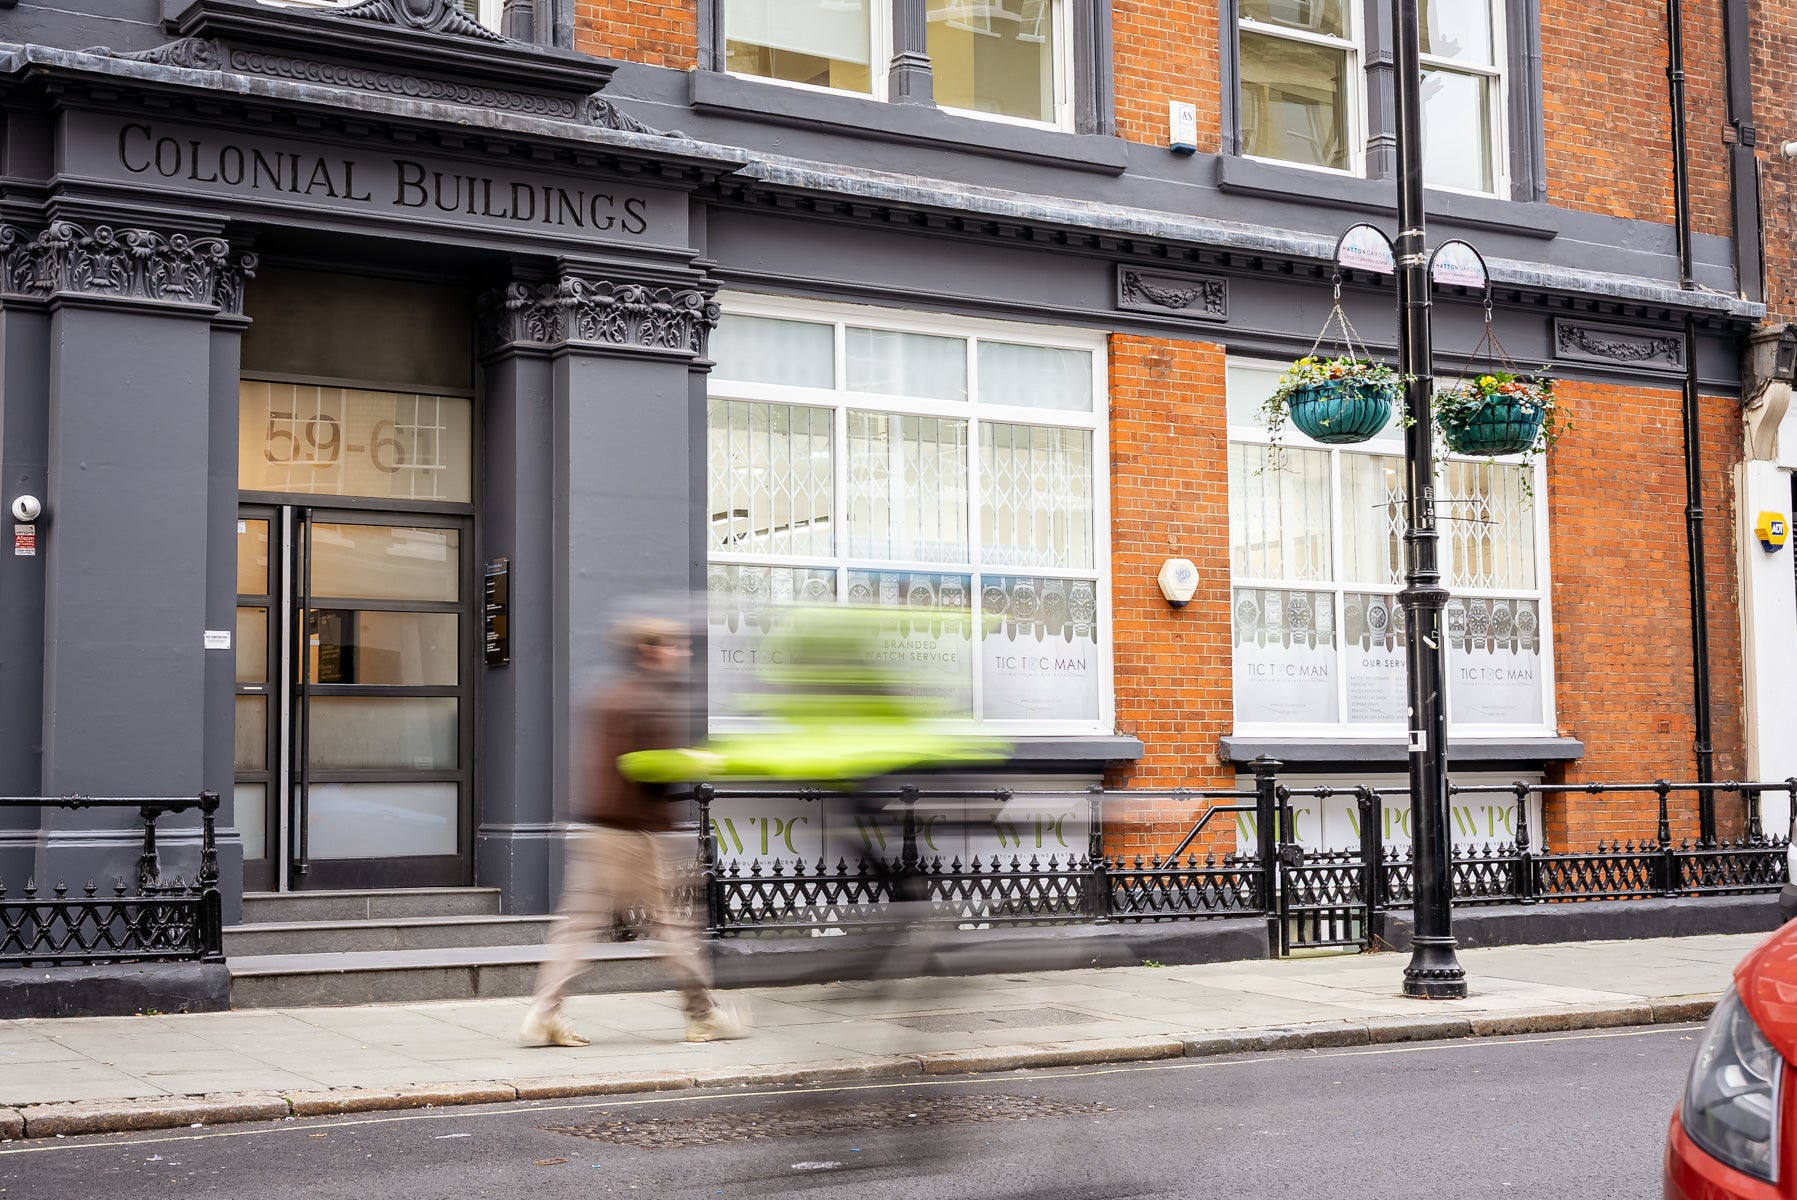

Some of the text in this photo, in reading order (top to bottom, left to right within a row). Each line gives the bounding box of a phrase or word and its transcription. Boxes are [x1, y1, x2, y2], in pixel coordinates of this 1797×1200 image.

[1182, 111, 1193, 121] AS
[118, 122, 648, 235] COLONIAL BUILDINGS
[264, 411, 431, 475] 59-61
[884, 640, 937, 650] BRANDED
[721, 649, 744, 663] TIC
[864, 650, 957, 662] WATCH SERVICE
[995, 656, 1016, 669] TIC
[1054, 658, 1086, 670] MAN
[1248, 663, 1265, 676] TIC
[1300, 665, 1328, 676] MAN
[1362, 659, 1406, 668] OUR SERV
[1460, 668, 1477, 680] TIC
[1507, 669, 1533, 680] MAN
[709, 816, 808, 855] WPC
[989, 812, 1076, 848] WPC
